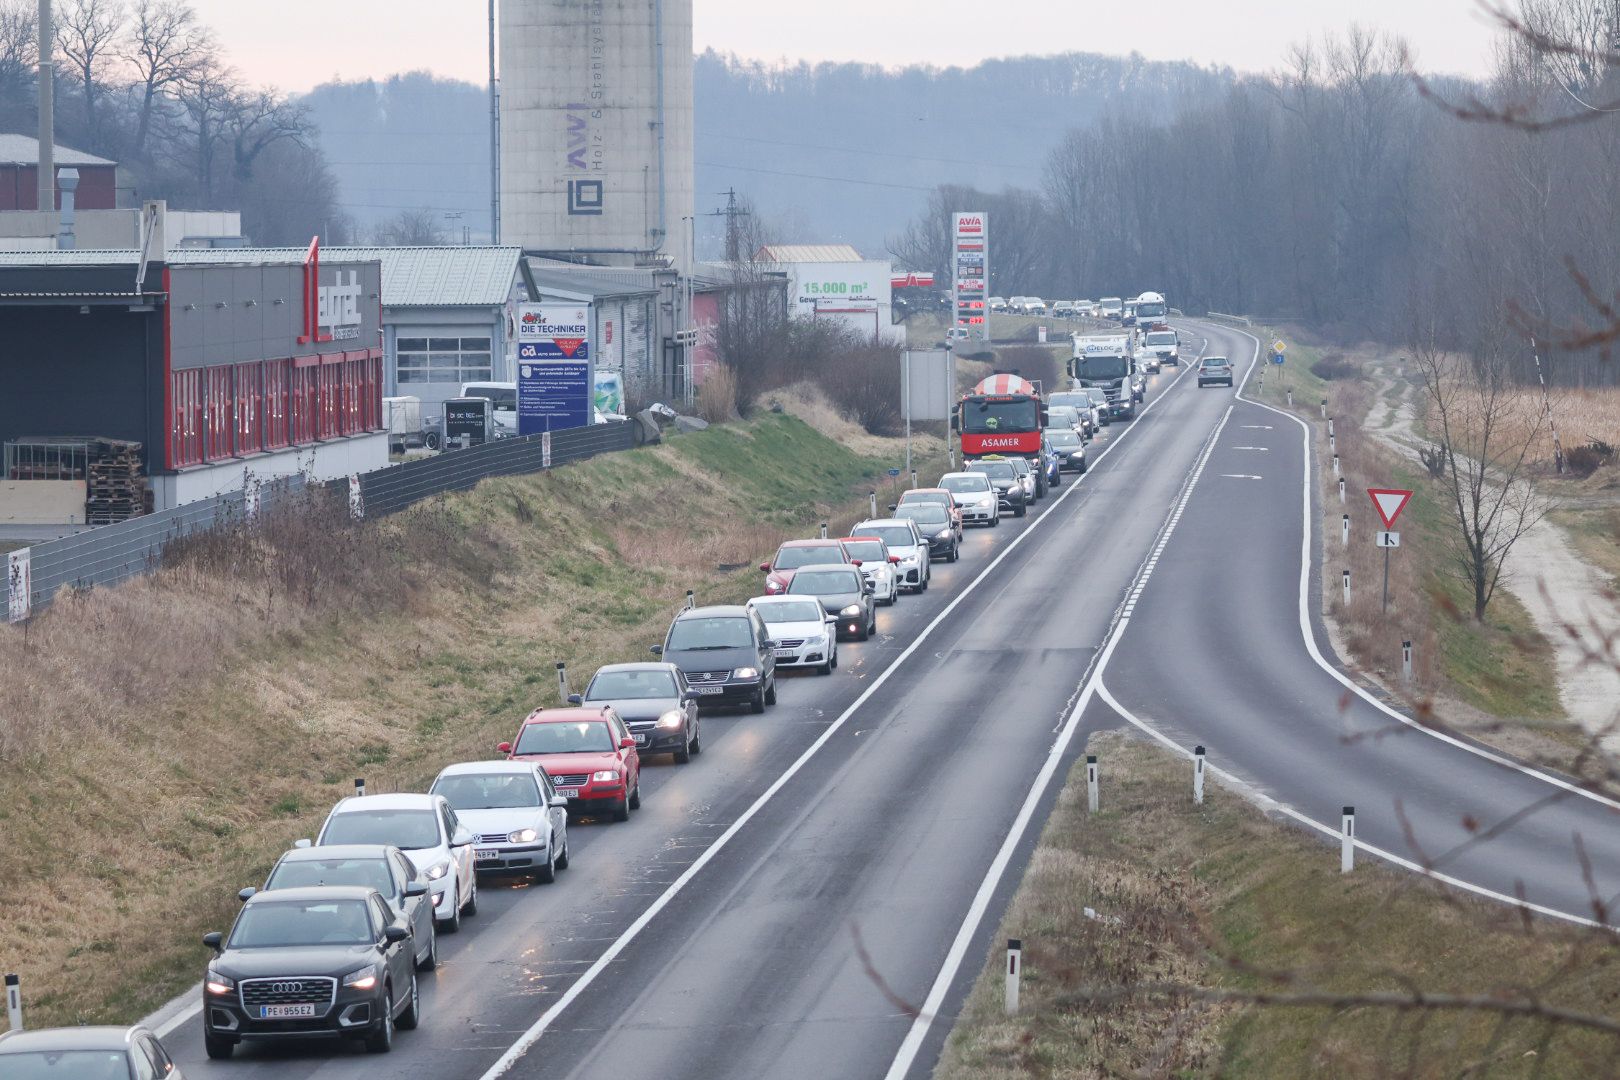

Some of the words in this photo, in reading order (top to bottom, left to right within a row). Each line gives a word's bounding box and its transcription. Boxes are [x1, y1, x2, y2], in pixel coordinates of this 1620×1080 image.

[591, 128, 603, 170] Holz-
[804, 282, 847, 294] 15.000
[521, 325, 535, 333] DIE
[538, 325, 586, 333] TECHNIKER
[981, 437, 1019, 447] ASAMER
